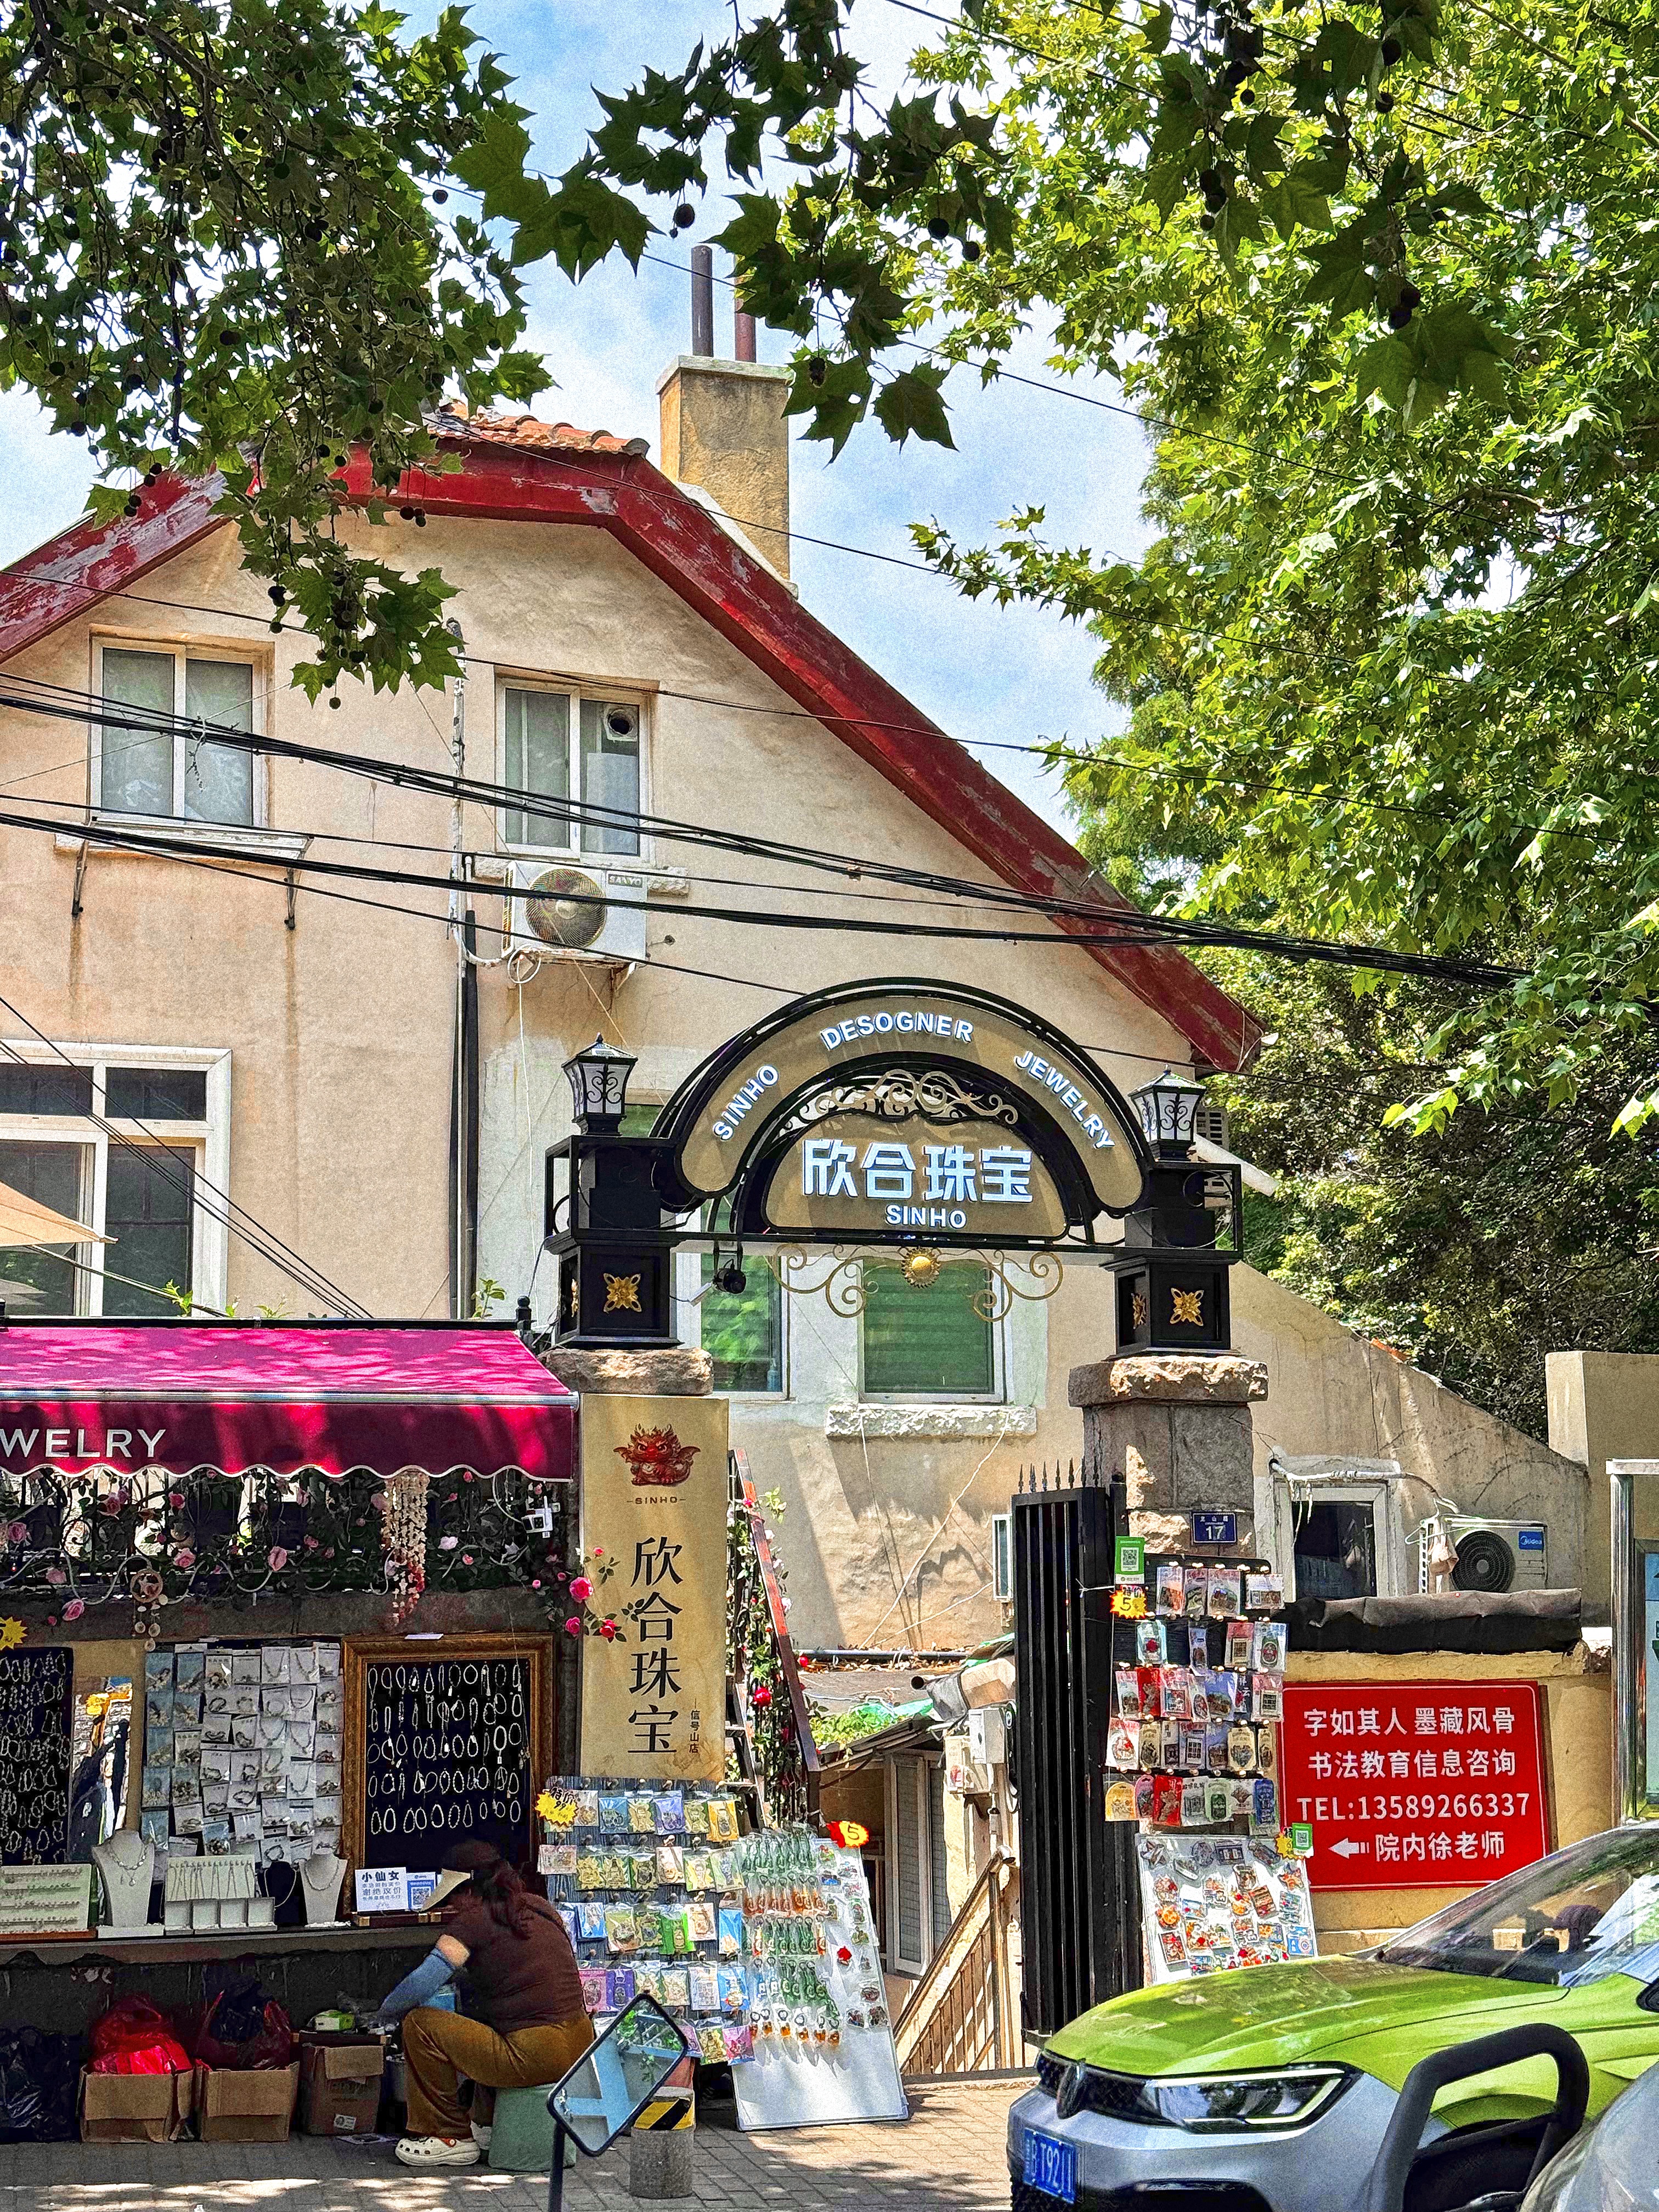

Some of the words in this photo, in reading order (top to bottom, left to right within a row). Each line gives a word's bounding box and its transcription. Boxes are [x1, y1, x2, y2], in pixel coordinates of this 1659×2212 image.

[714, 1065, 780, 1141] SINHO
[820, 1011, 974, 1051] DESOGNER
[1013, 1050, 1116, 1151] JEWELRY
[802, 1138, 1034, 1203] 欣合珠宝
[886, 1204, 967, 1229] SINHO
[0, 1429, 166, 1458] WELRY
[635, 1496, 678, 1504] SINHO
[1205, 1525, 1224, 1540] 17
[627, 1537, 684, 1754] 欣合珠宝
[689, 1709, 701, 1753] 信号山店
[1304, 1707, 1408, 1737] 字如其人
[1414, 1706, 1515, 1735] 墨藏风骨
[1308, 1748, 1516, 1780] 书法教育信息咨询
[1296, 1792, 1530, 1821] TEL:13589266337
[1375, 1830, 1505, 1862] 院内徐老师
[361, 1870, 400, 1883] 小仙女
